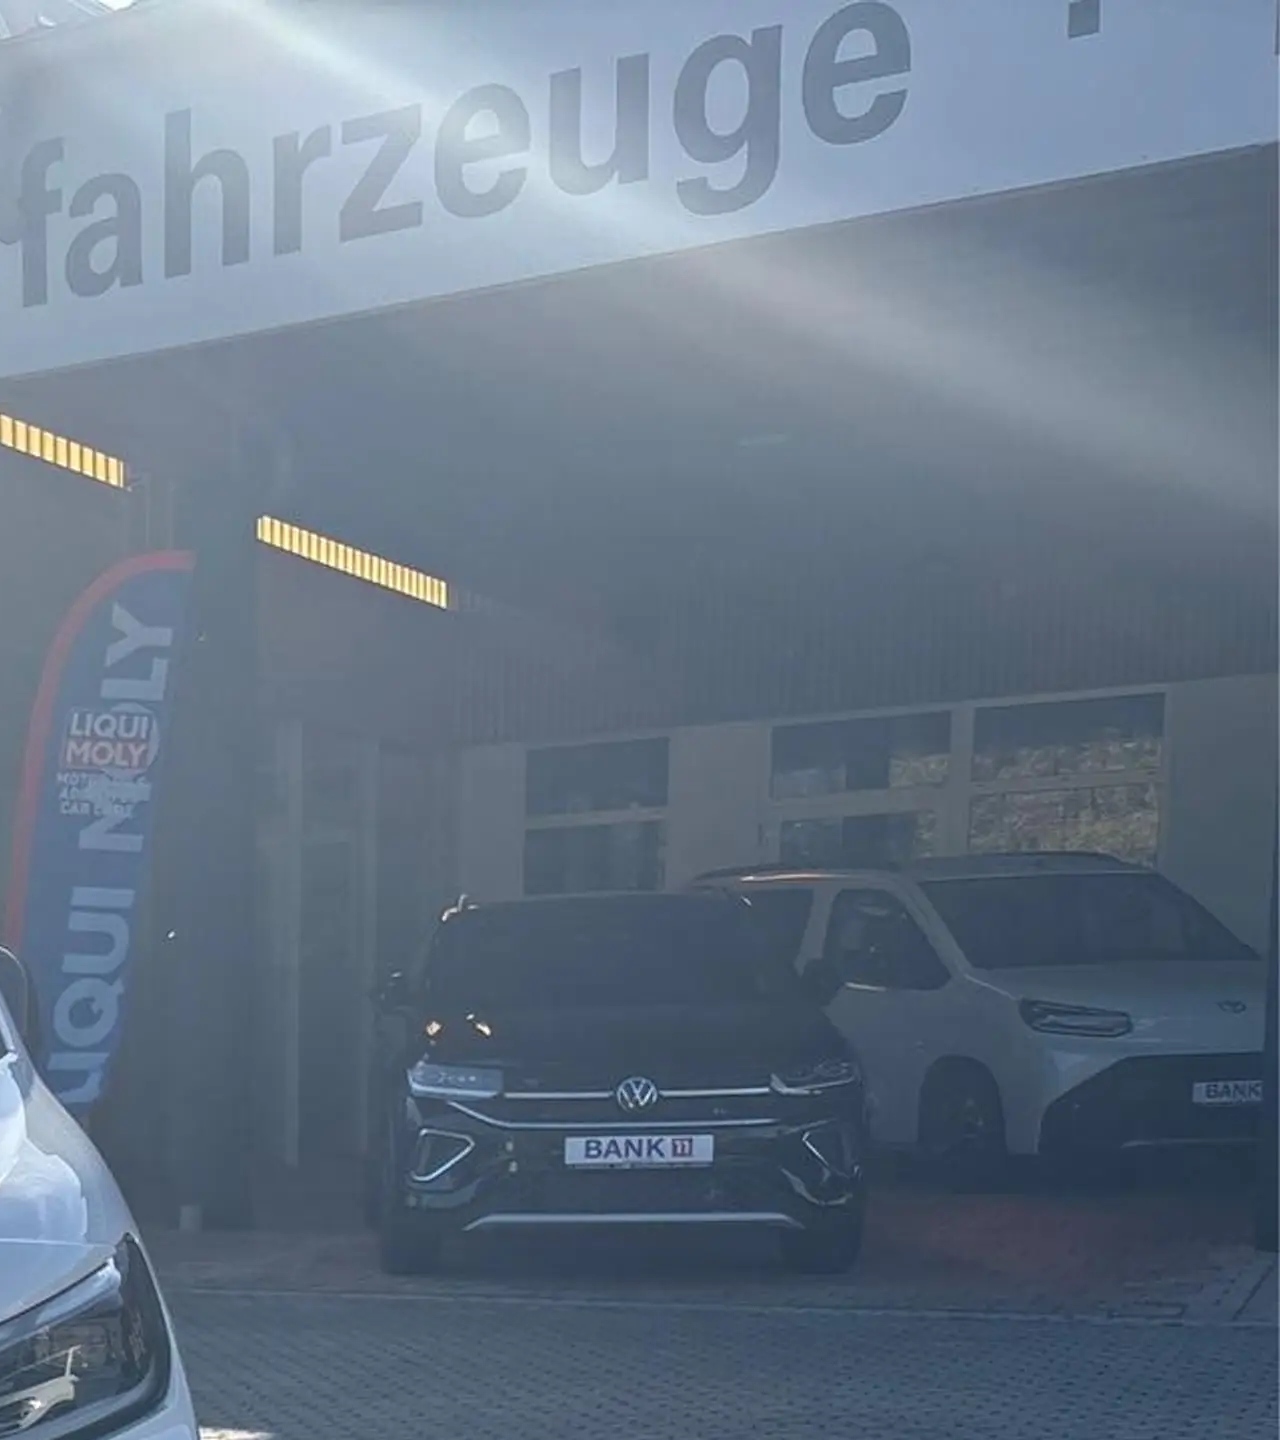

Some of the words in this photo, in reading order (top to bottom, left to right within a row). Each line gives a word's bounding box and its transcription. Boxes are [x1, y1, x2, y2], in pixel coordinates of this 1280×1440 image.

[69, 711, 149, 740] LIQUI
[65, 739, 148, 768] MOLY
[47, 887, 136, 1104] LIQUI
[1205, 1082, 1262, 1099] BANK
[583, 1137, 666, 1160] BANK
